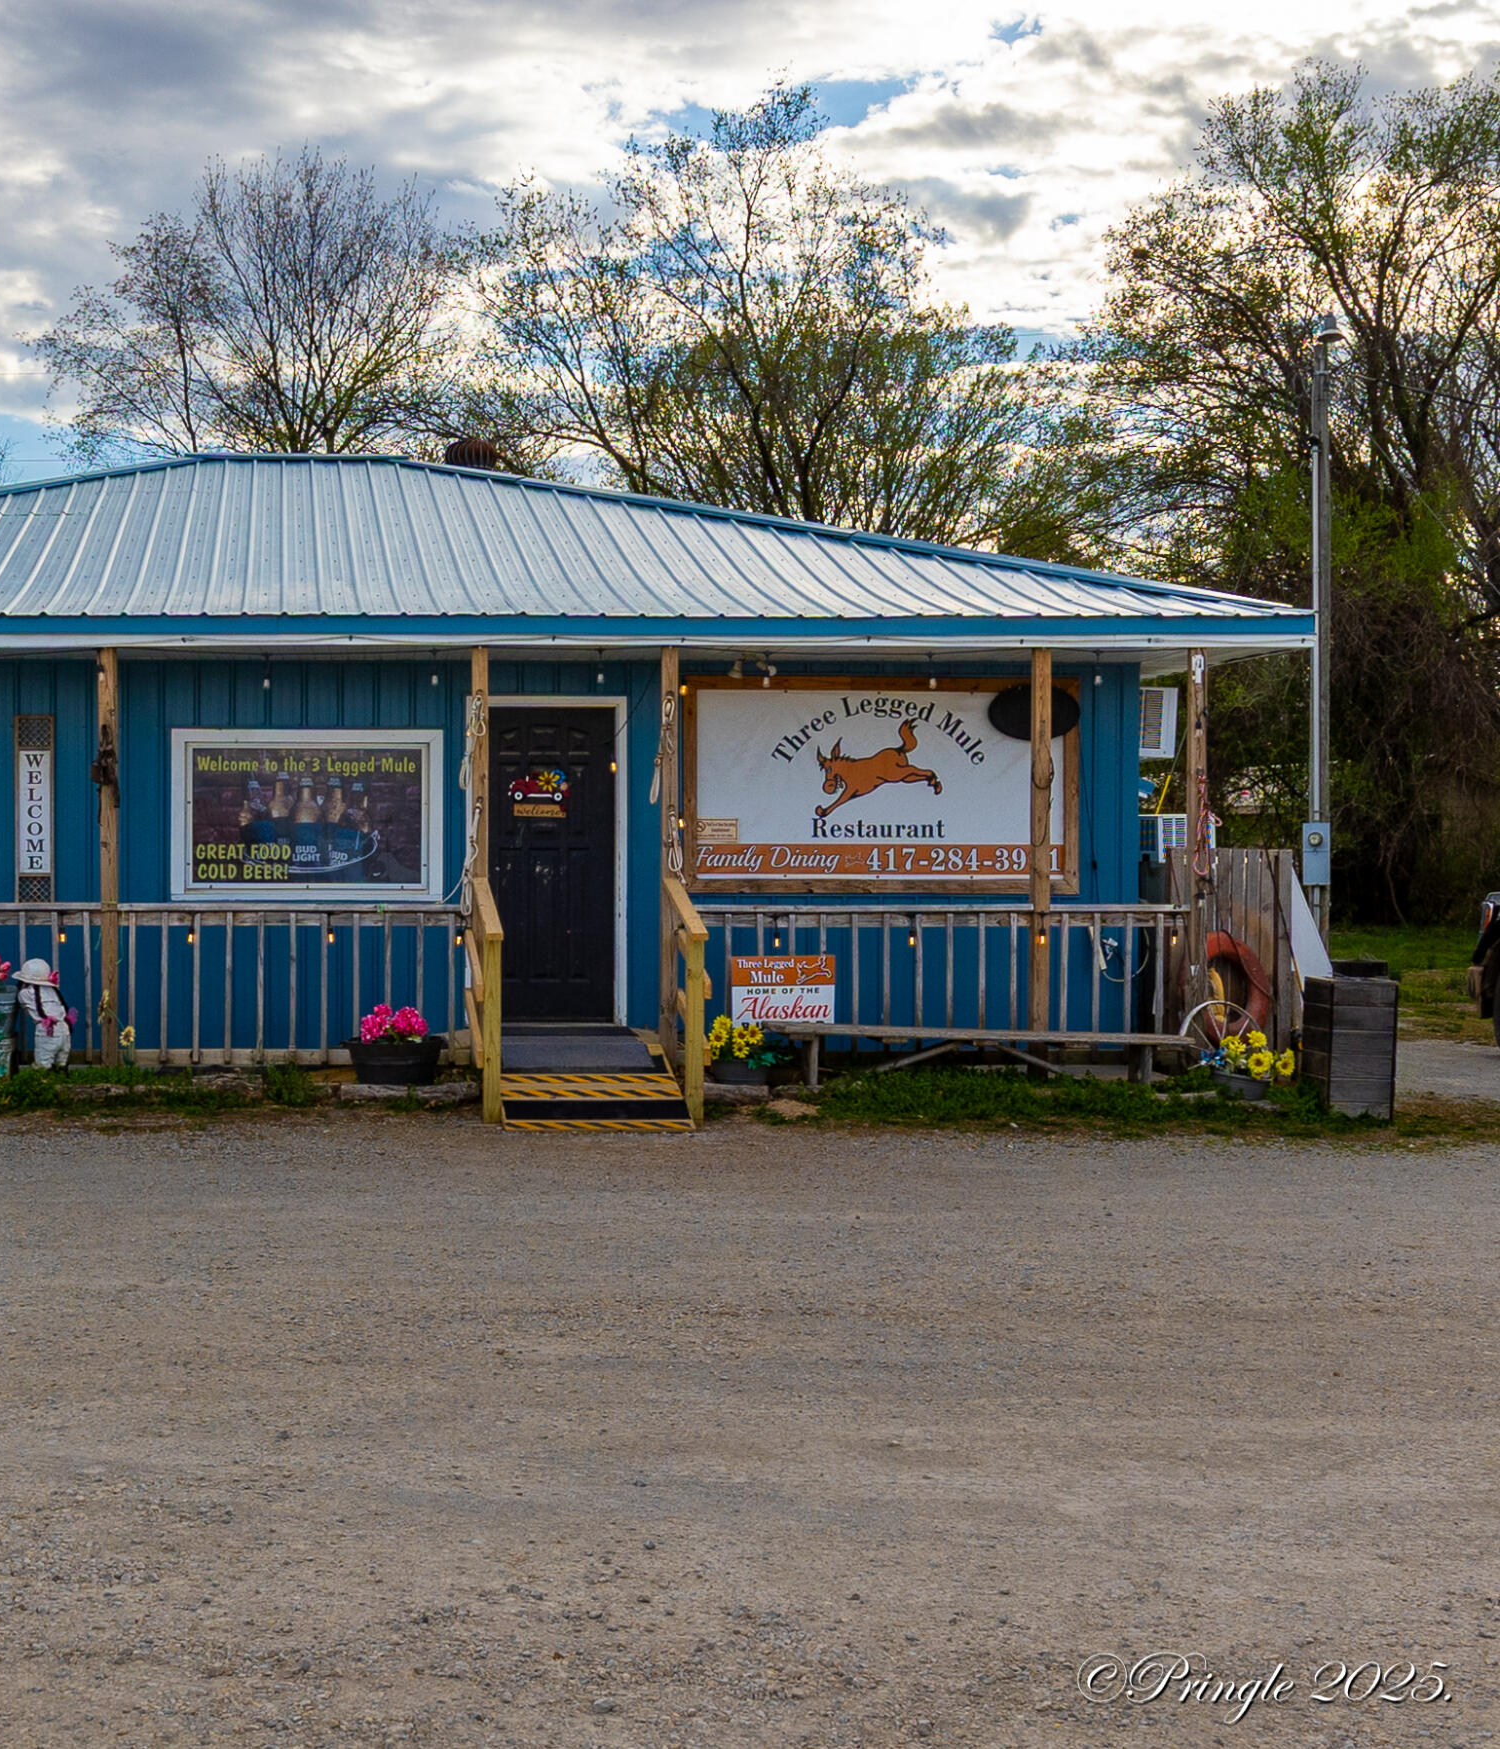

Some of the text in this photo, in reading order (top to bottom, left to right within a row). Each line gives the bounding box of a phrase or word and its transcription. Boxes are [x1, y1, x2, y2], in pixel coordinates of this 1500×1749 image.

[771, 696, 986, 766] Three Legged Mule
[197, 755, 416, 777] Welcome to the 3 Legged Mule
[25, 753, 45, 870] WELCOME
[811, 817, 946, 839] Restaurant
[196, 844, 291, 860] GREAT FOOD
[292, 853, 320, 862] LIGHT
[295, 845, 317, 854] BUD
[696, 845, 1062, 874] Family Dining 417-284-391
[198, 863, 288, 880] COLD BEER!
[737, 958, 795, 970] Three Legged
[750, 970, 785, 984] Mule
[747, 987, 777, 995] HOME
[781, 987, 795, 995] OF
[736, 994, 831, 1020] Alaskan
